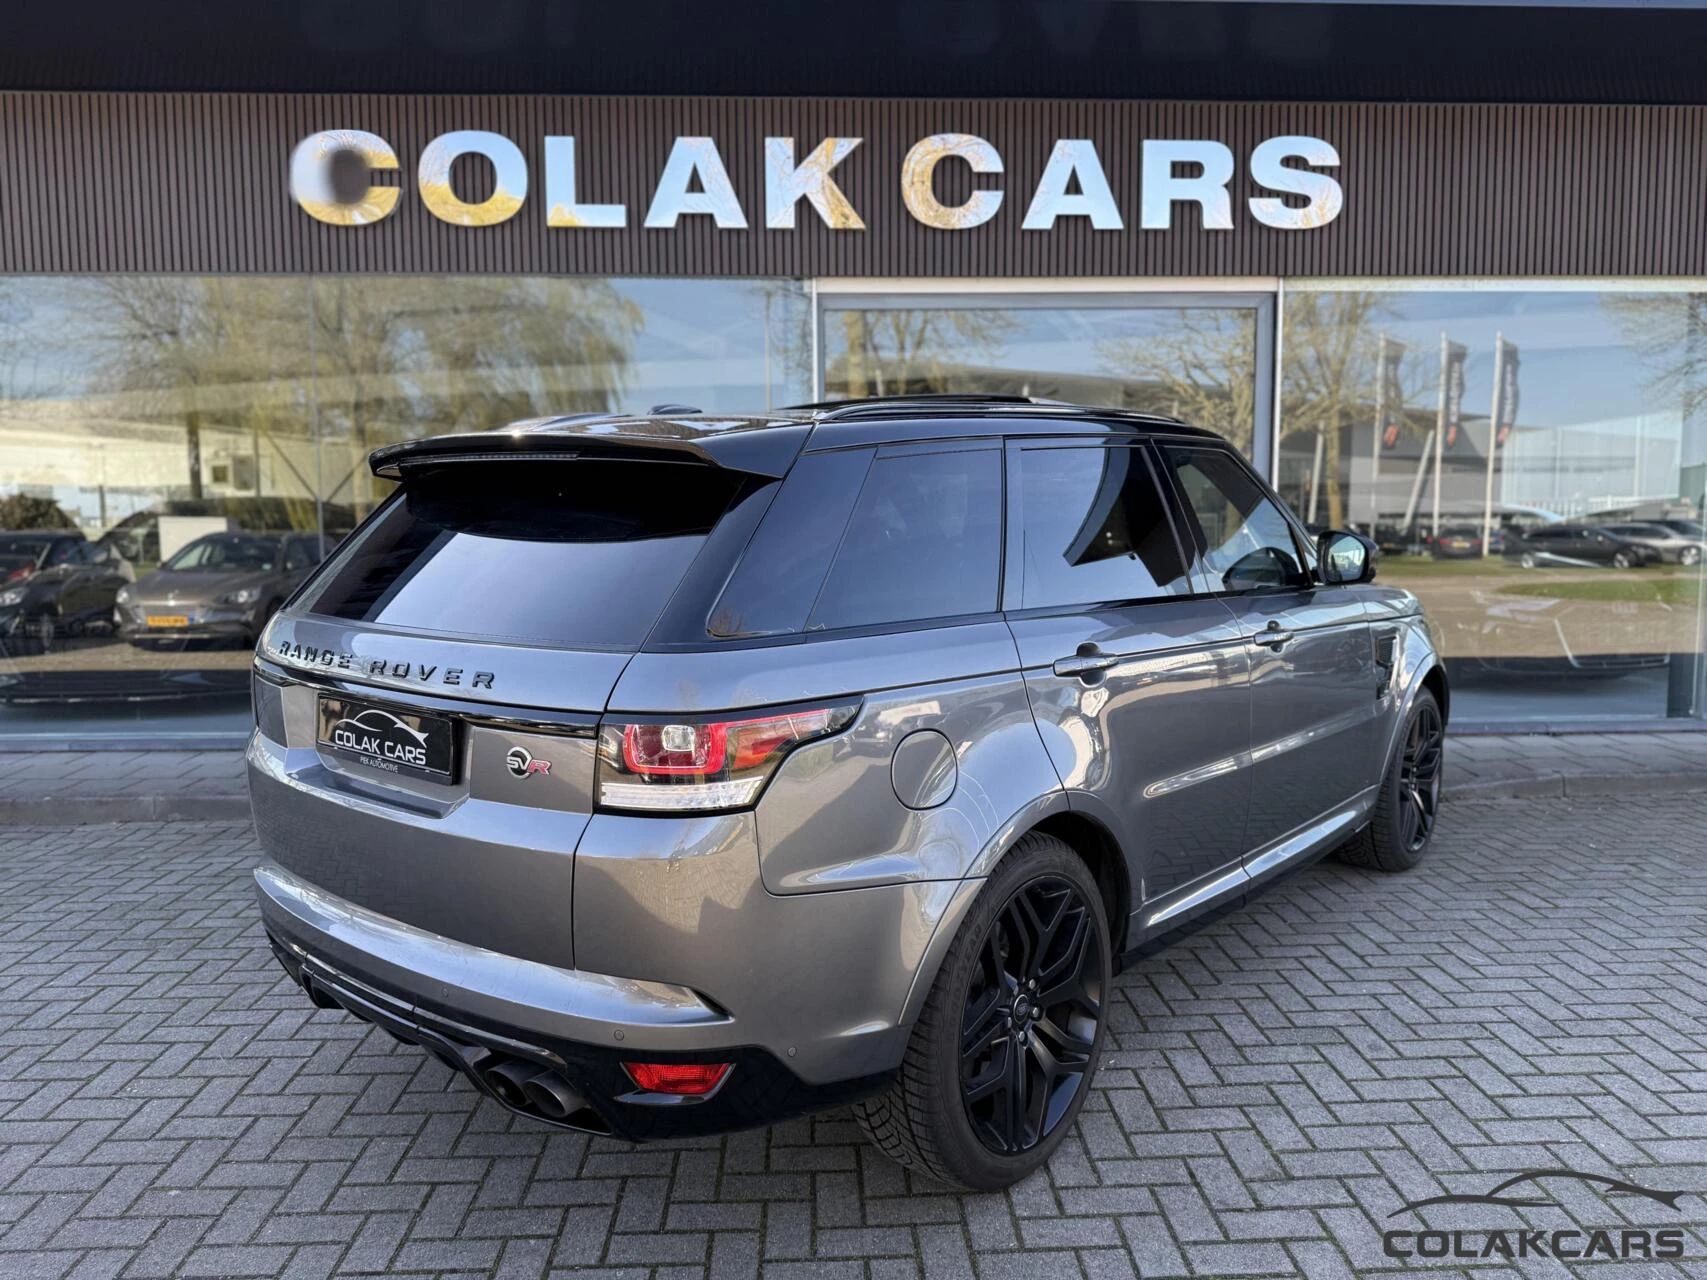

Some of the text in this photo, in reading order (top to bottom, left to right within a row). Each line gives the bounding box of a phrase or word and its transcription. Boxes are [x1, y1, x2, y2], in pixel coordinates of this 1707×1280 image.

[289, 129, 1344, 229] COLAK CARS
[279, 640, 495, 689] RANGE ROVER
[335, 729, 427, 765] COLAK CARS
[506, 746, 552, 779] SVR
